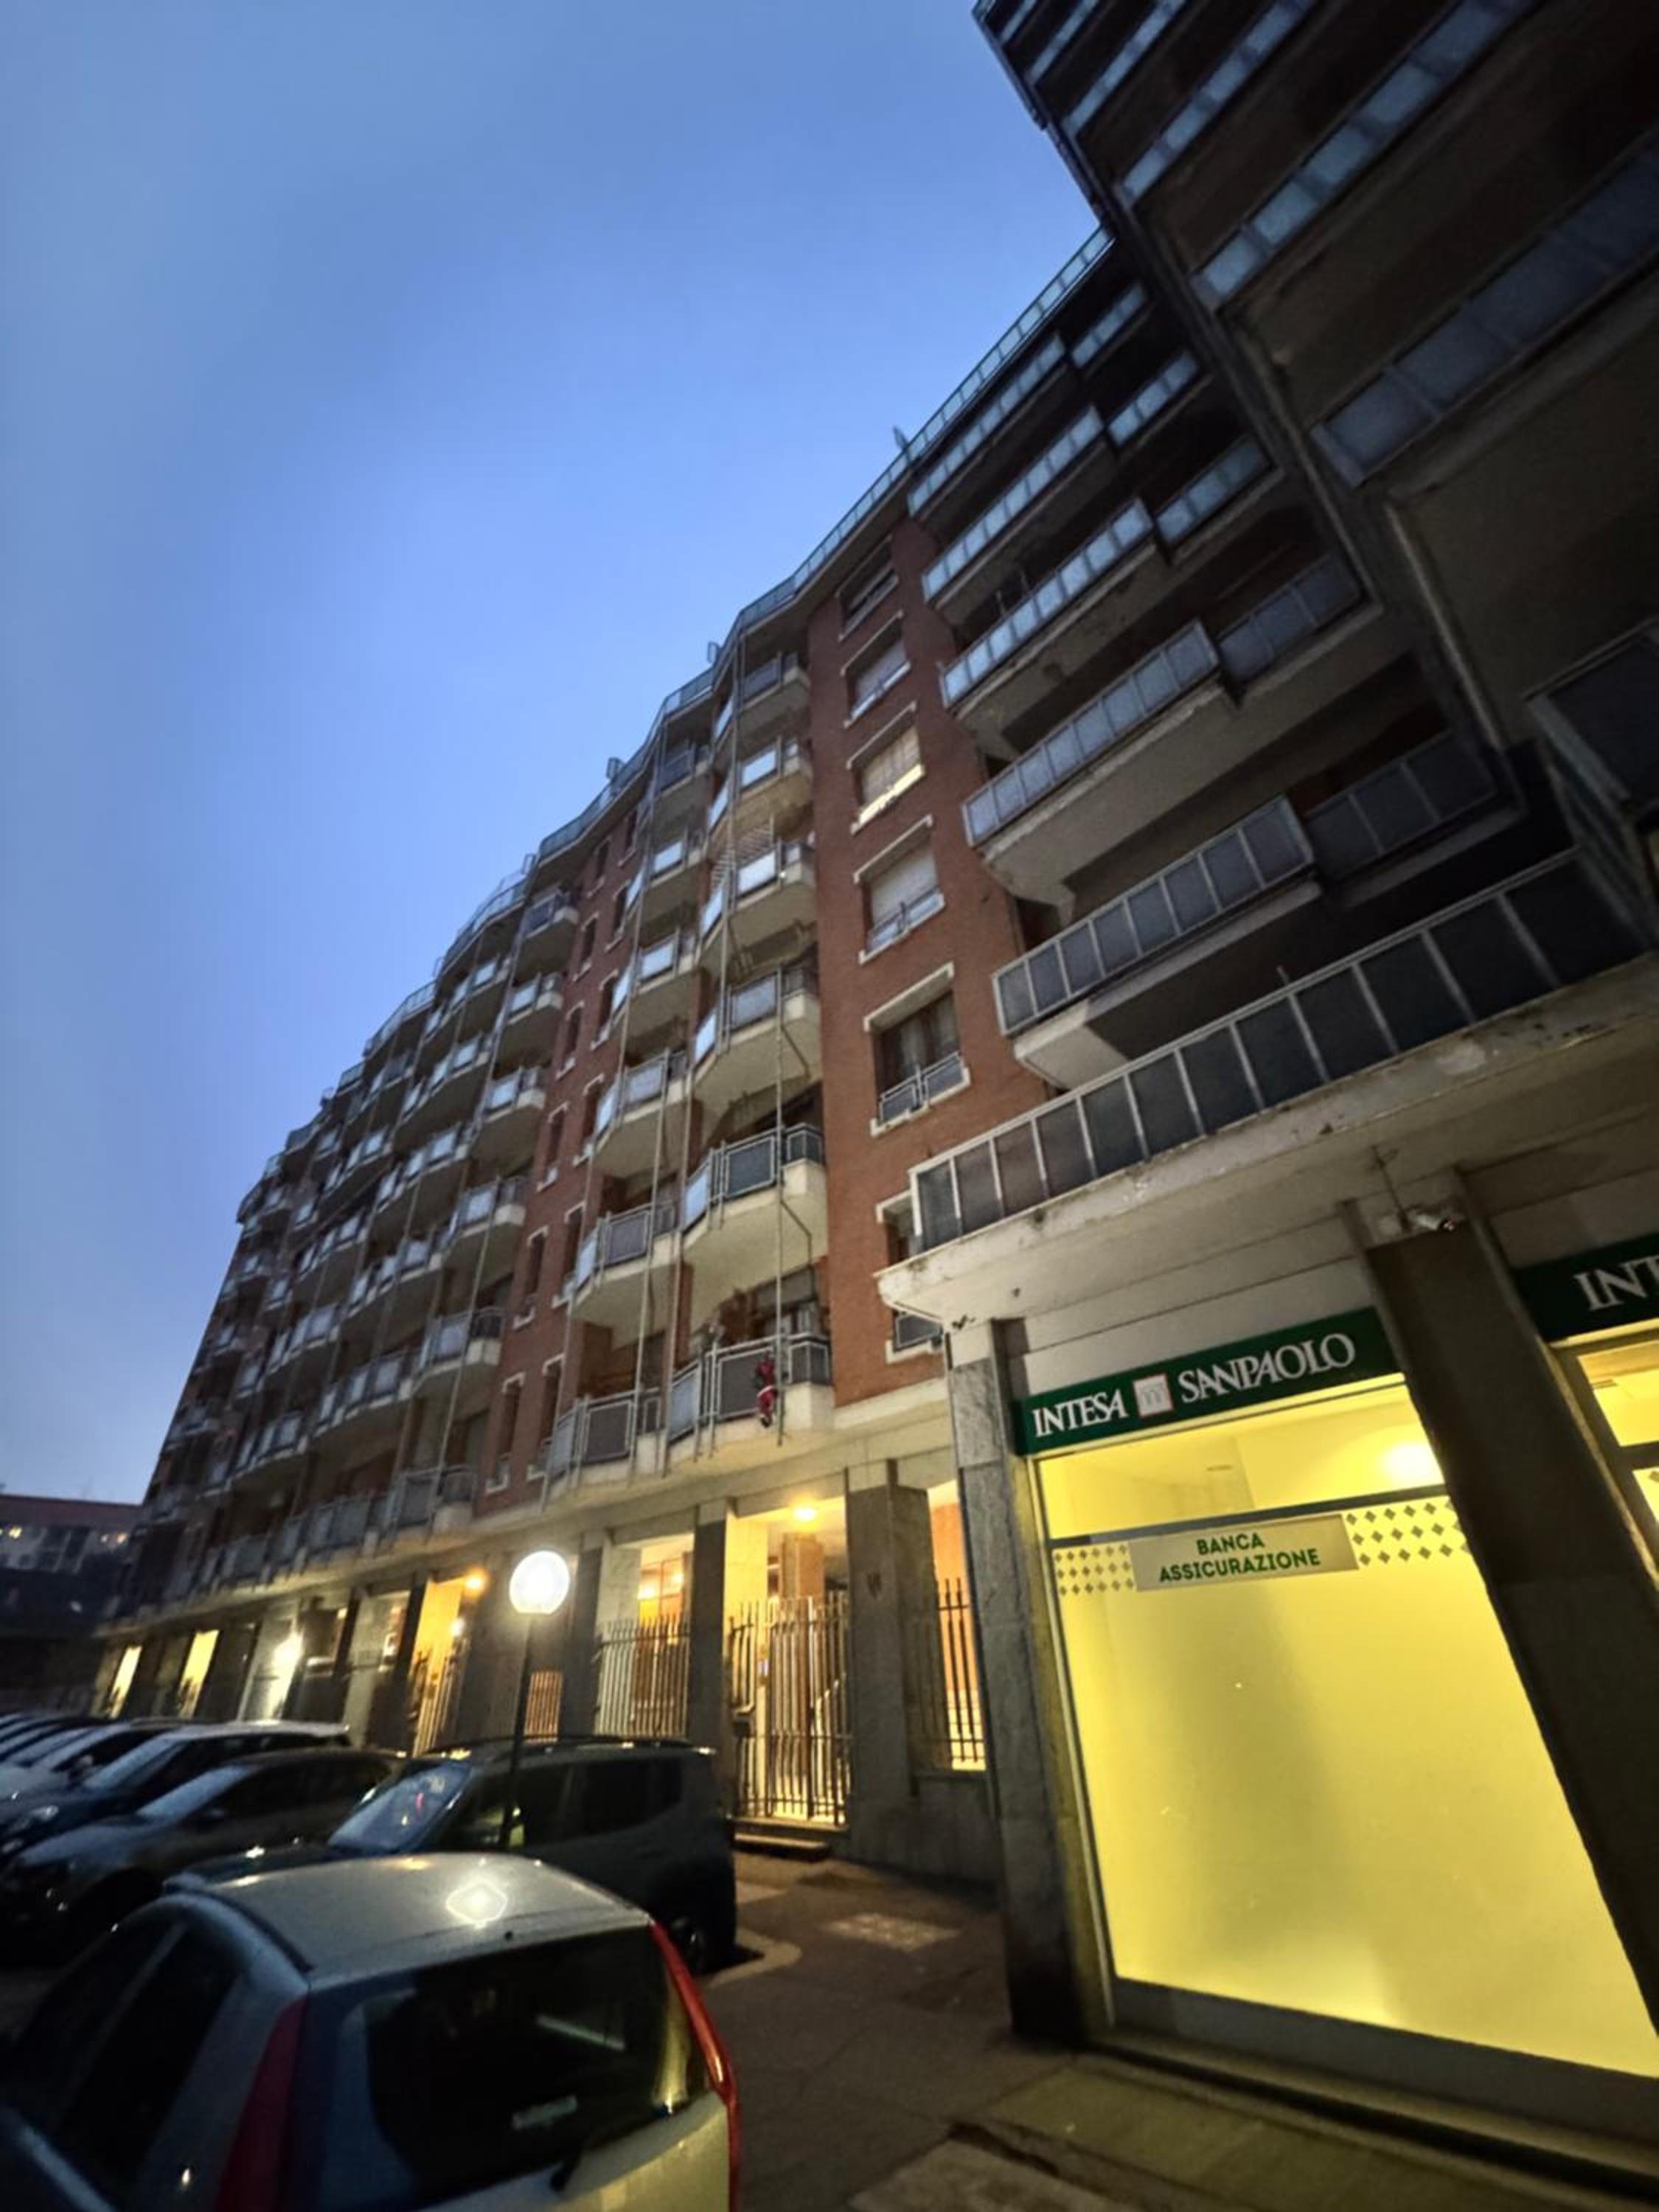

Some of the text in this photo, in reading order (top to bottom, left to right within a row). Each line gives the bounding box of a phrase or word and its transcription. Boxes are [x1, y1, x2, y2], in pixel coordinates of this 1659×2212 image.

[1032, 1333, 1355, 1437] INTESA SANPAOLO
[1196, 1532, 1265, 1555] BANCA
[1159, 1548, 1321, 1582] ASSICURAZIONE
